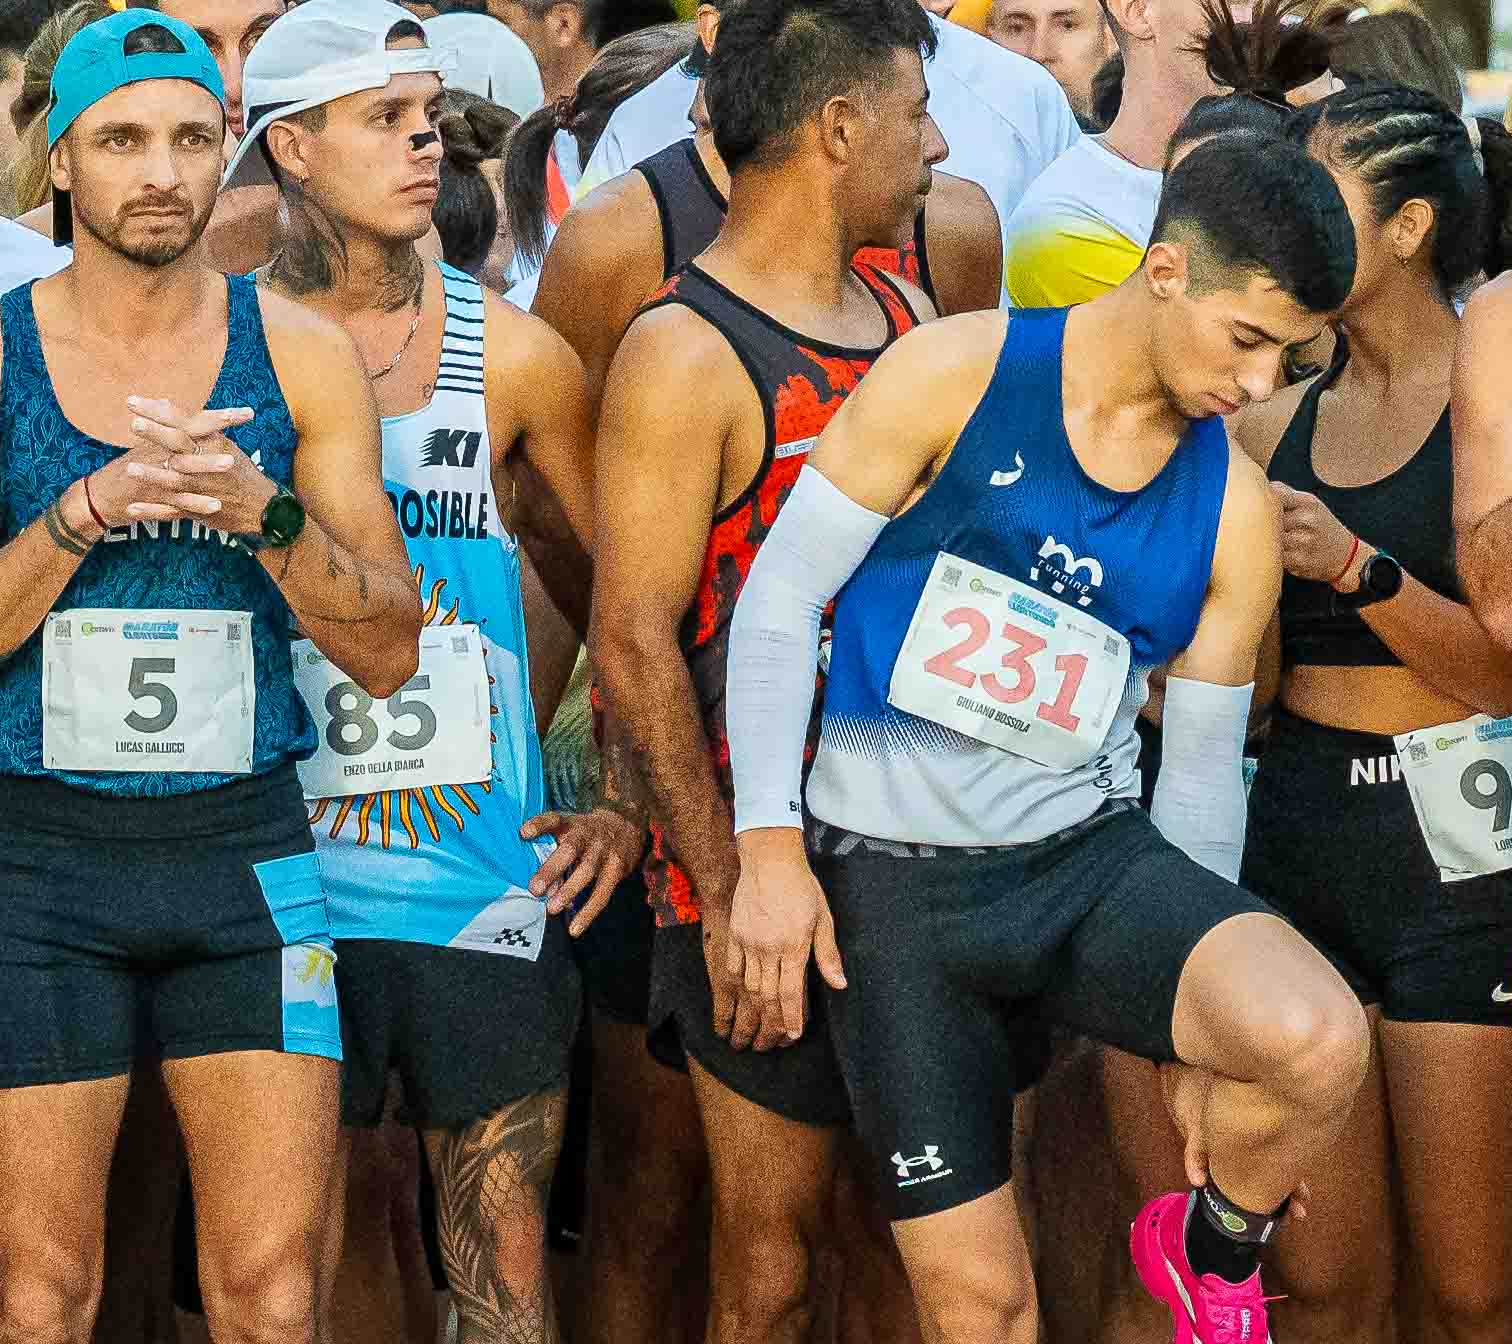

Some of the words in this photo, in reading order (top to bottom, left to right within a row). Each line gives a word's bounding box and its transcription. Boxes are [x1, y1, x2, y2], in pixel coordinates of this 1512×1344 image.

[1038, 559, 1090, 595] running
[924, 607, 1089, 734] 231
[124, 657, 177, 733] 5
[956, 695, 994, 722] GIULIANO
[994, 707, 1031, 733] BOSSOLA
[325, 674, 437, 756] 85
[116, 742, 144, 753] LUCAS
[145, 742, 185, 753] GALLUCCI
[344, 764, 365, 777] ENZO
[366, 761, 393, 774] DELLA
